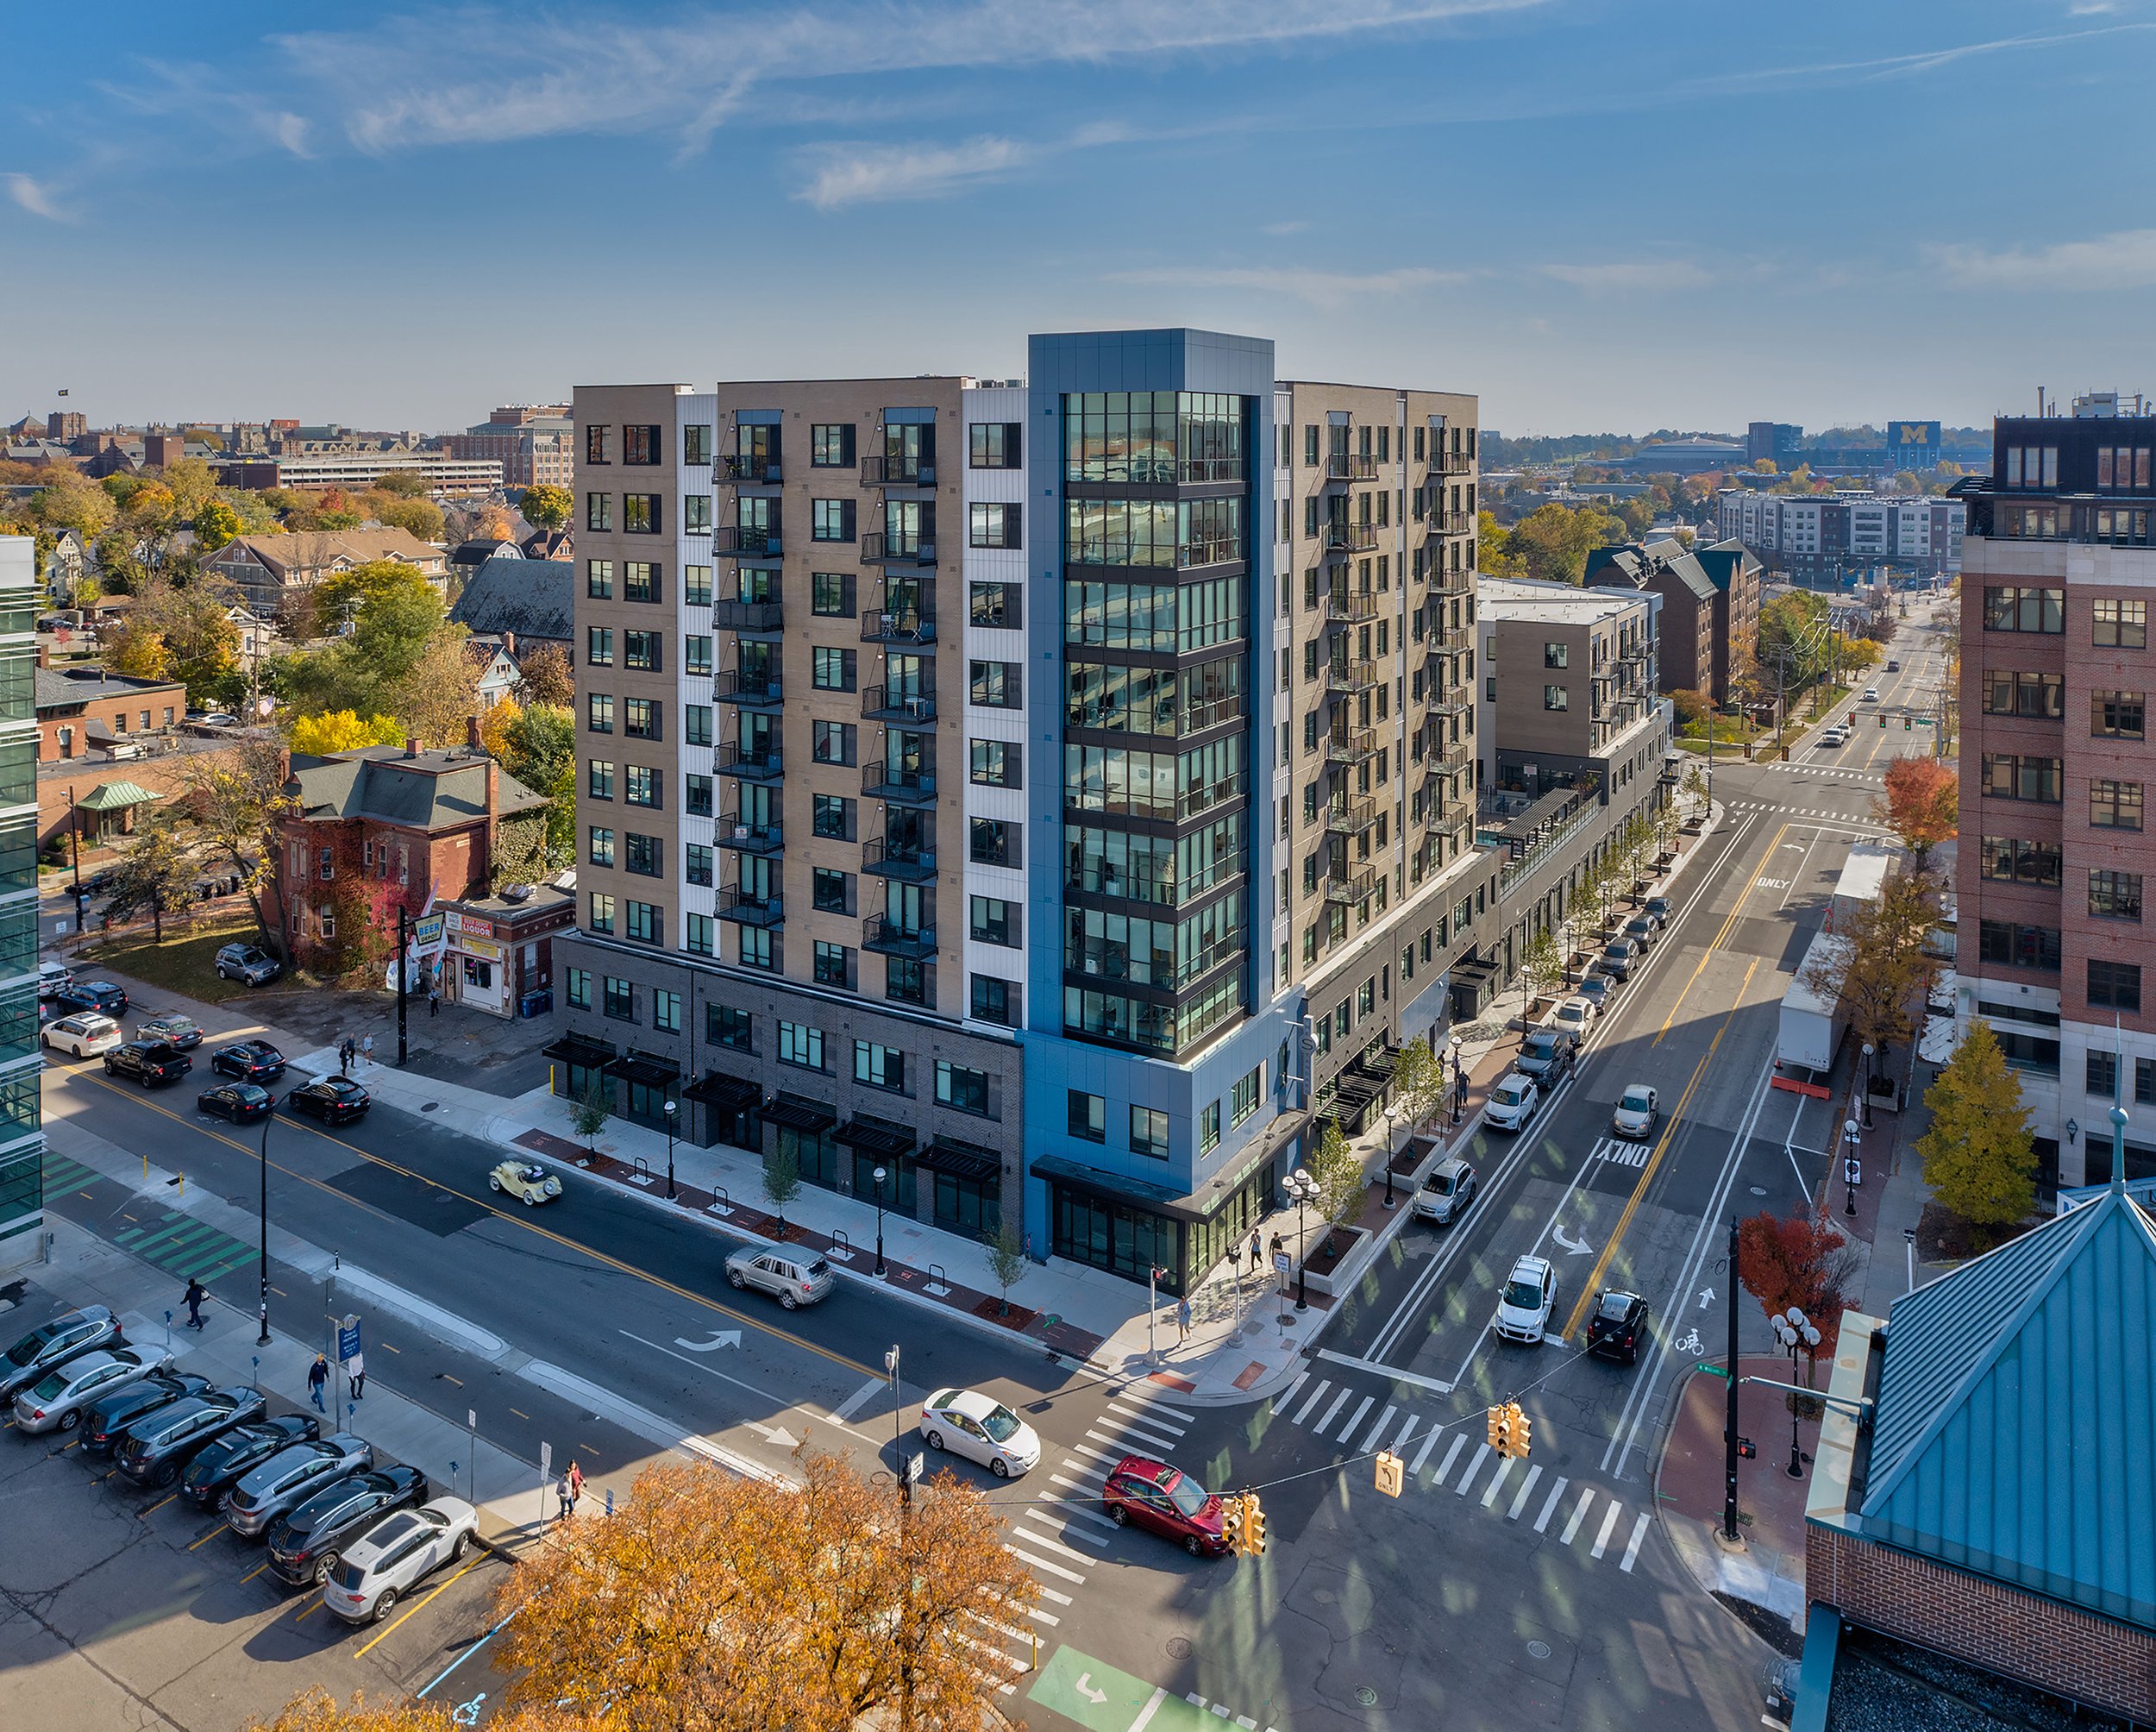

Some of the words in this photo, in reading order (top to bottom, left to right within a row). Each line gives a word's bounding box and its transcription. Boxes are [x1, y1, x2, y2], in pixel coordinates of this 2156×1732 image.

[1901, 425, 1927, 444] M
[1757, 876, 1790, 888] ONLY
[418, 922, 440, 937] BEER
[463, 924, 491, 937] LIQUOR
[421, 933, 437, 942] DEPOT
[1595, 1139, 1651, 1168] ONLY
[1377, 1482, 1394, 1492] ONLY
